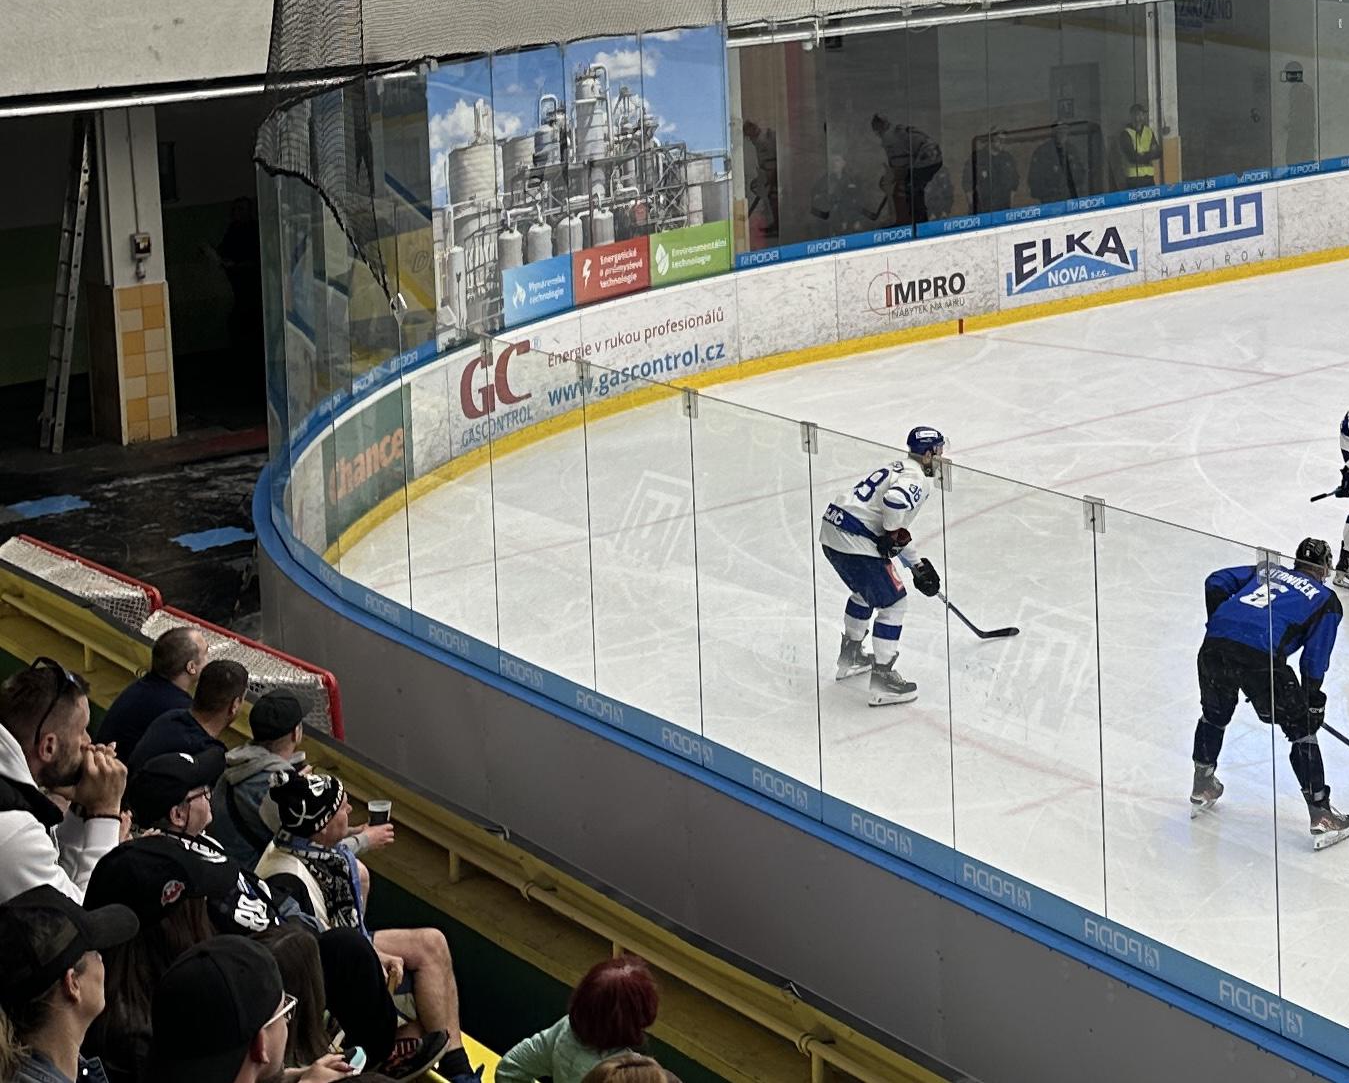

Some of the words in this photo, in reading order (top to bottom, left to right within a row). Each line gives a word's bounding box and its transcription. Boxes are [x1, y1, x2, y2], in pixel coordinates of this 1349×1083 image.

[1014, 226, 1130, 287] ELKA
[1048, 266, 1088, 286] NOVA
[885, 272, 966, 308] IMPRO
[547, 343, 592, 368] Energie
[594, 340, 601, 353] v
[604, 329, 641, 349] rukou
[645, 306, 725, 346] profesionálů
[460, 339, 532, 421] GC
[547, 341, 726, 408] www.gascontrol.cz
[461, 403, 534, 449] GASCONTROL
